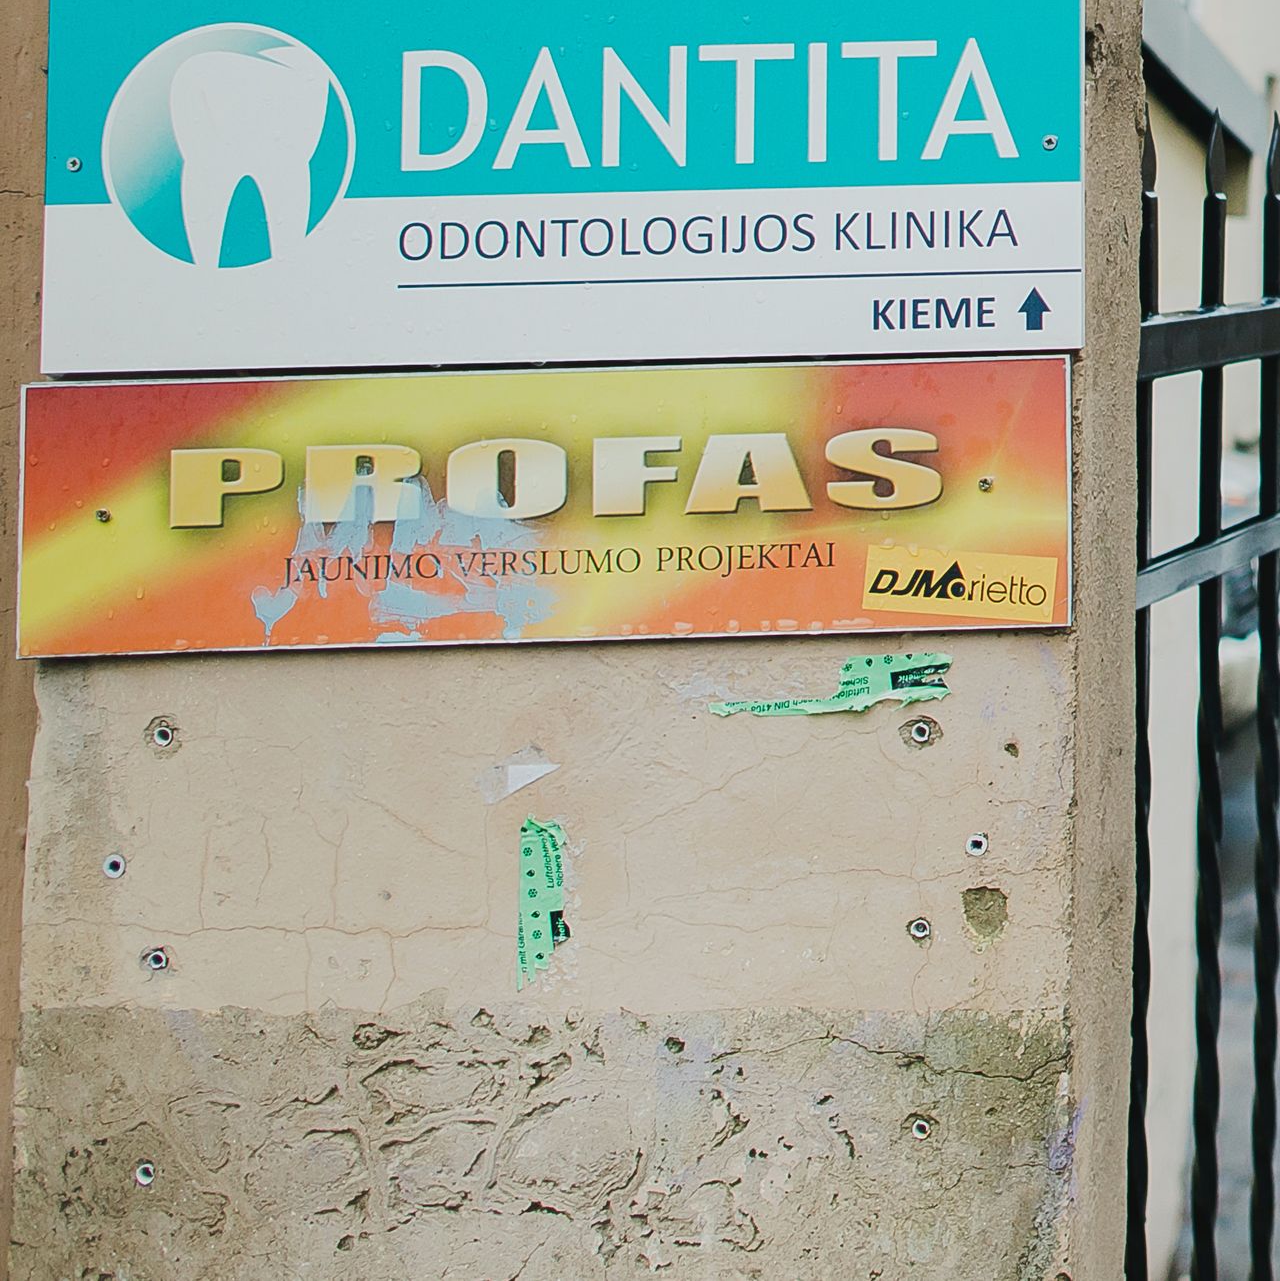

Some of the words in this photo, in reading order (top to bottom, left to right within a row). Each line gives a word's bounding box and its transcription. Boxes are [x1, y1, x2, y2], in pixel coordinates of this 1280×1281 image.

[400, 36, 1021, 174] DANTITA
[398, 211, 816, 263] ODONTOLOGIJOS
[833, 207, 1020, 253] KLINIKA
[870, 294, 998, 332] KIEME
[169, 425, 946, 529] PROFAS
[282, 553, 442, 591] JAUNIMO
[454, 546, 643, 579] VERSLUMO
[656, 540, 838, 576] PROJEKTAI
